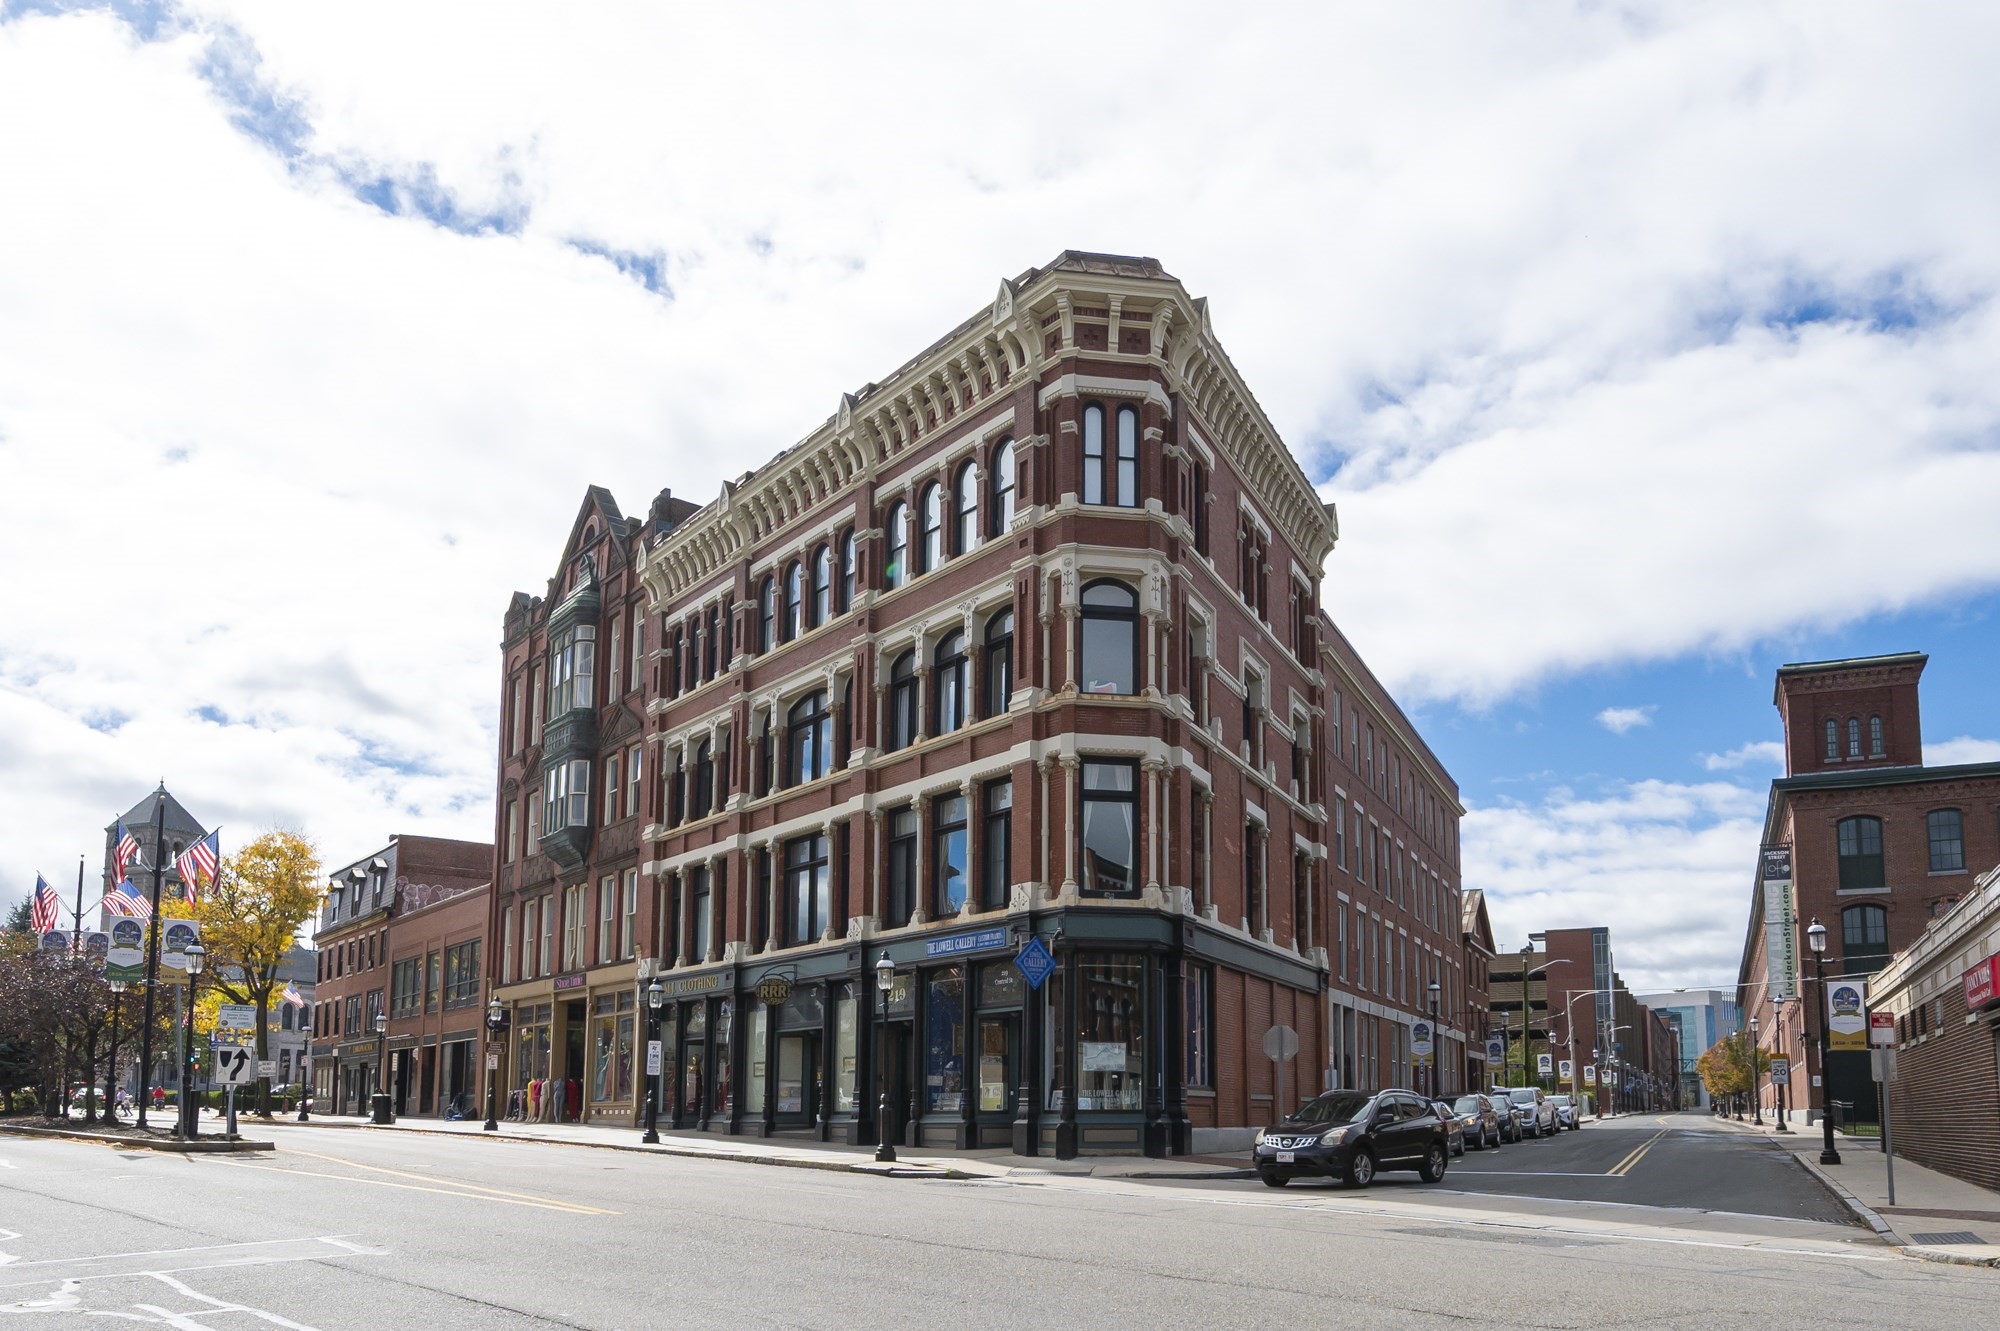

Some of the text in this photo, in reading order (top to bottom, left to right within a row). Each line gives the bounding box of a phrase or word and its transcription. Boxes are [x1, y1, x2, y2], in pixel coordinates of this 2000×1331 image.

[927, 943, 936, 954] THE
[936, 940, 954, 953] LOWELL
[954, 936, 977, 950] GALLERY
[1782, 885, 1794, 996] LiveJacksonStreet.com
[1023, 958, 1047, 967] GALLERY
[556, 976, 583, 989] Shoe Time
[679, 976, 718, 992] CLOTHING
[760, 985, 787, 998] RRR
[888, 987, 906, 1001] 219
[1837, 990, 1855, 998] 200
[1082, 1089, 1092, 1097] THE
[1093, 1089, 1113, 1097] LOWELL
